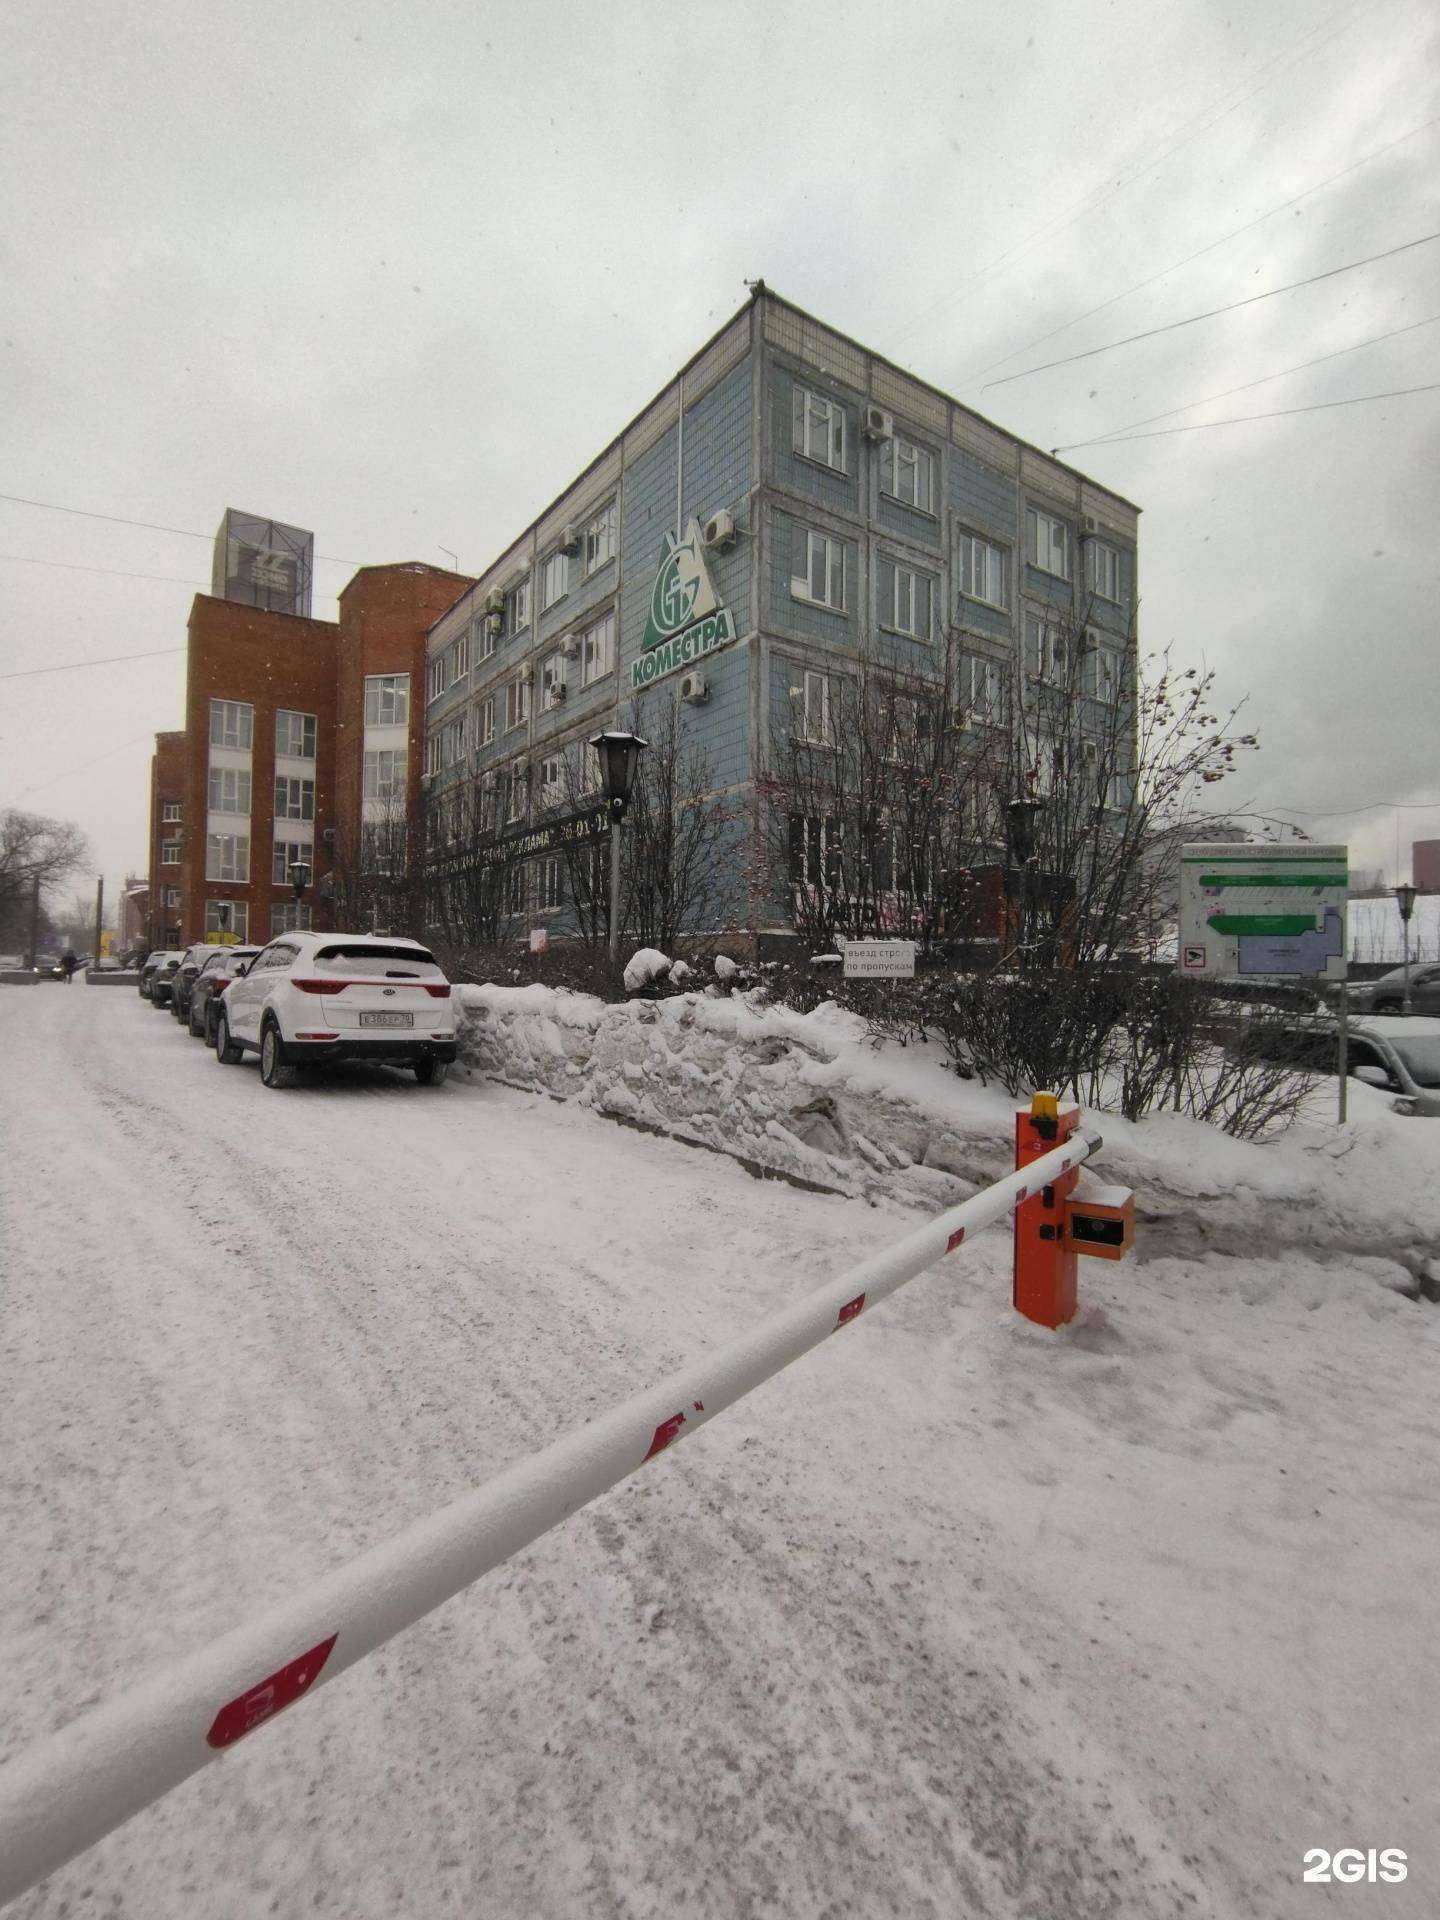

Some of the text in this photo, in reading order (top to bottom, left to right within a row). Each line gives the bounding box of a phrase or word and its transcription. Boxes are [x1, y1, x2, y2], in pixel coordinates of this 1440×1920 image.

[632, 613, 730, 687] КОМЕСТРА
[848, 950, 876, 958] въезд
[861, 963, 913, 972] пропускам
